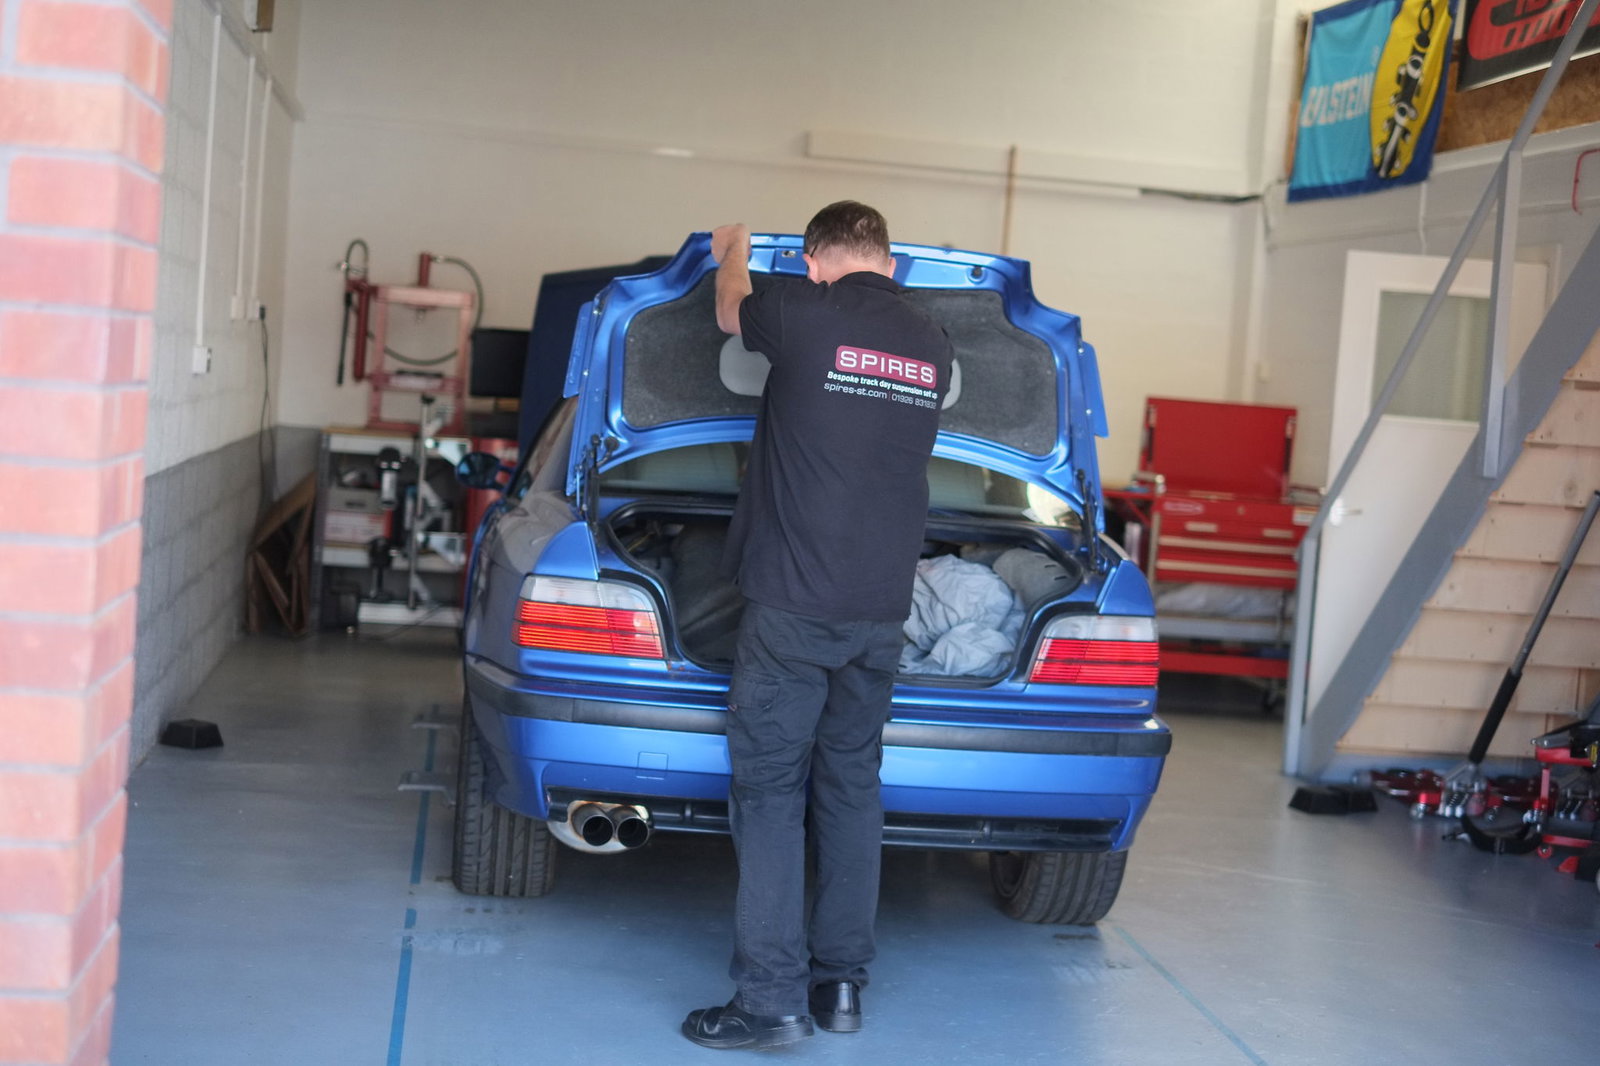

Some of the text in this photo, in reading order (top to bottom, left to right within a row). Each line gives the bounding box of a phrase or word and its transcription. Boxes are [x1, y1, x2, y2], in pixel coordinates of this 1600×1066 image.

[840, 350, 933, 384] SPIRES
[827, 371, 859, 384] Bespoke
[860, 376, 878, 387] track
[879, 380, 892, 390] day
[823, 382, 887, 399] spires-st.com
